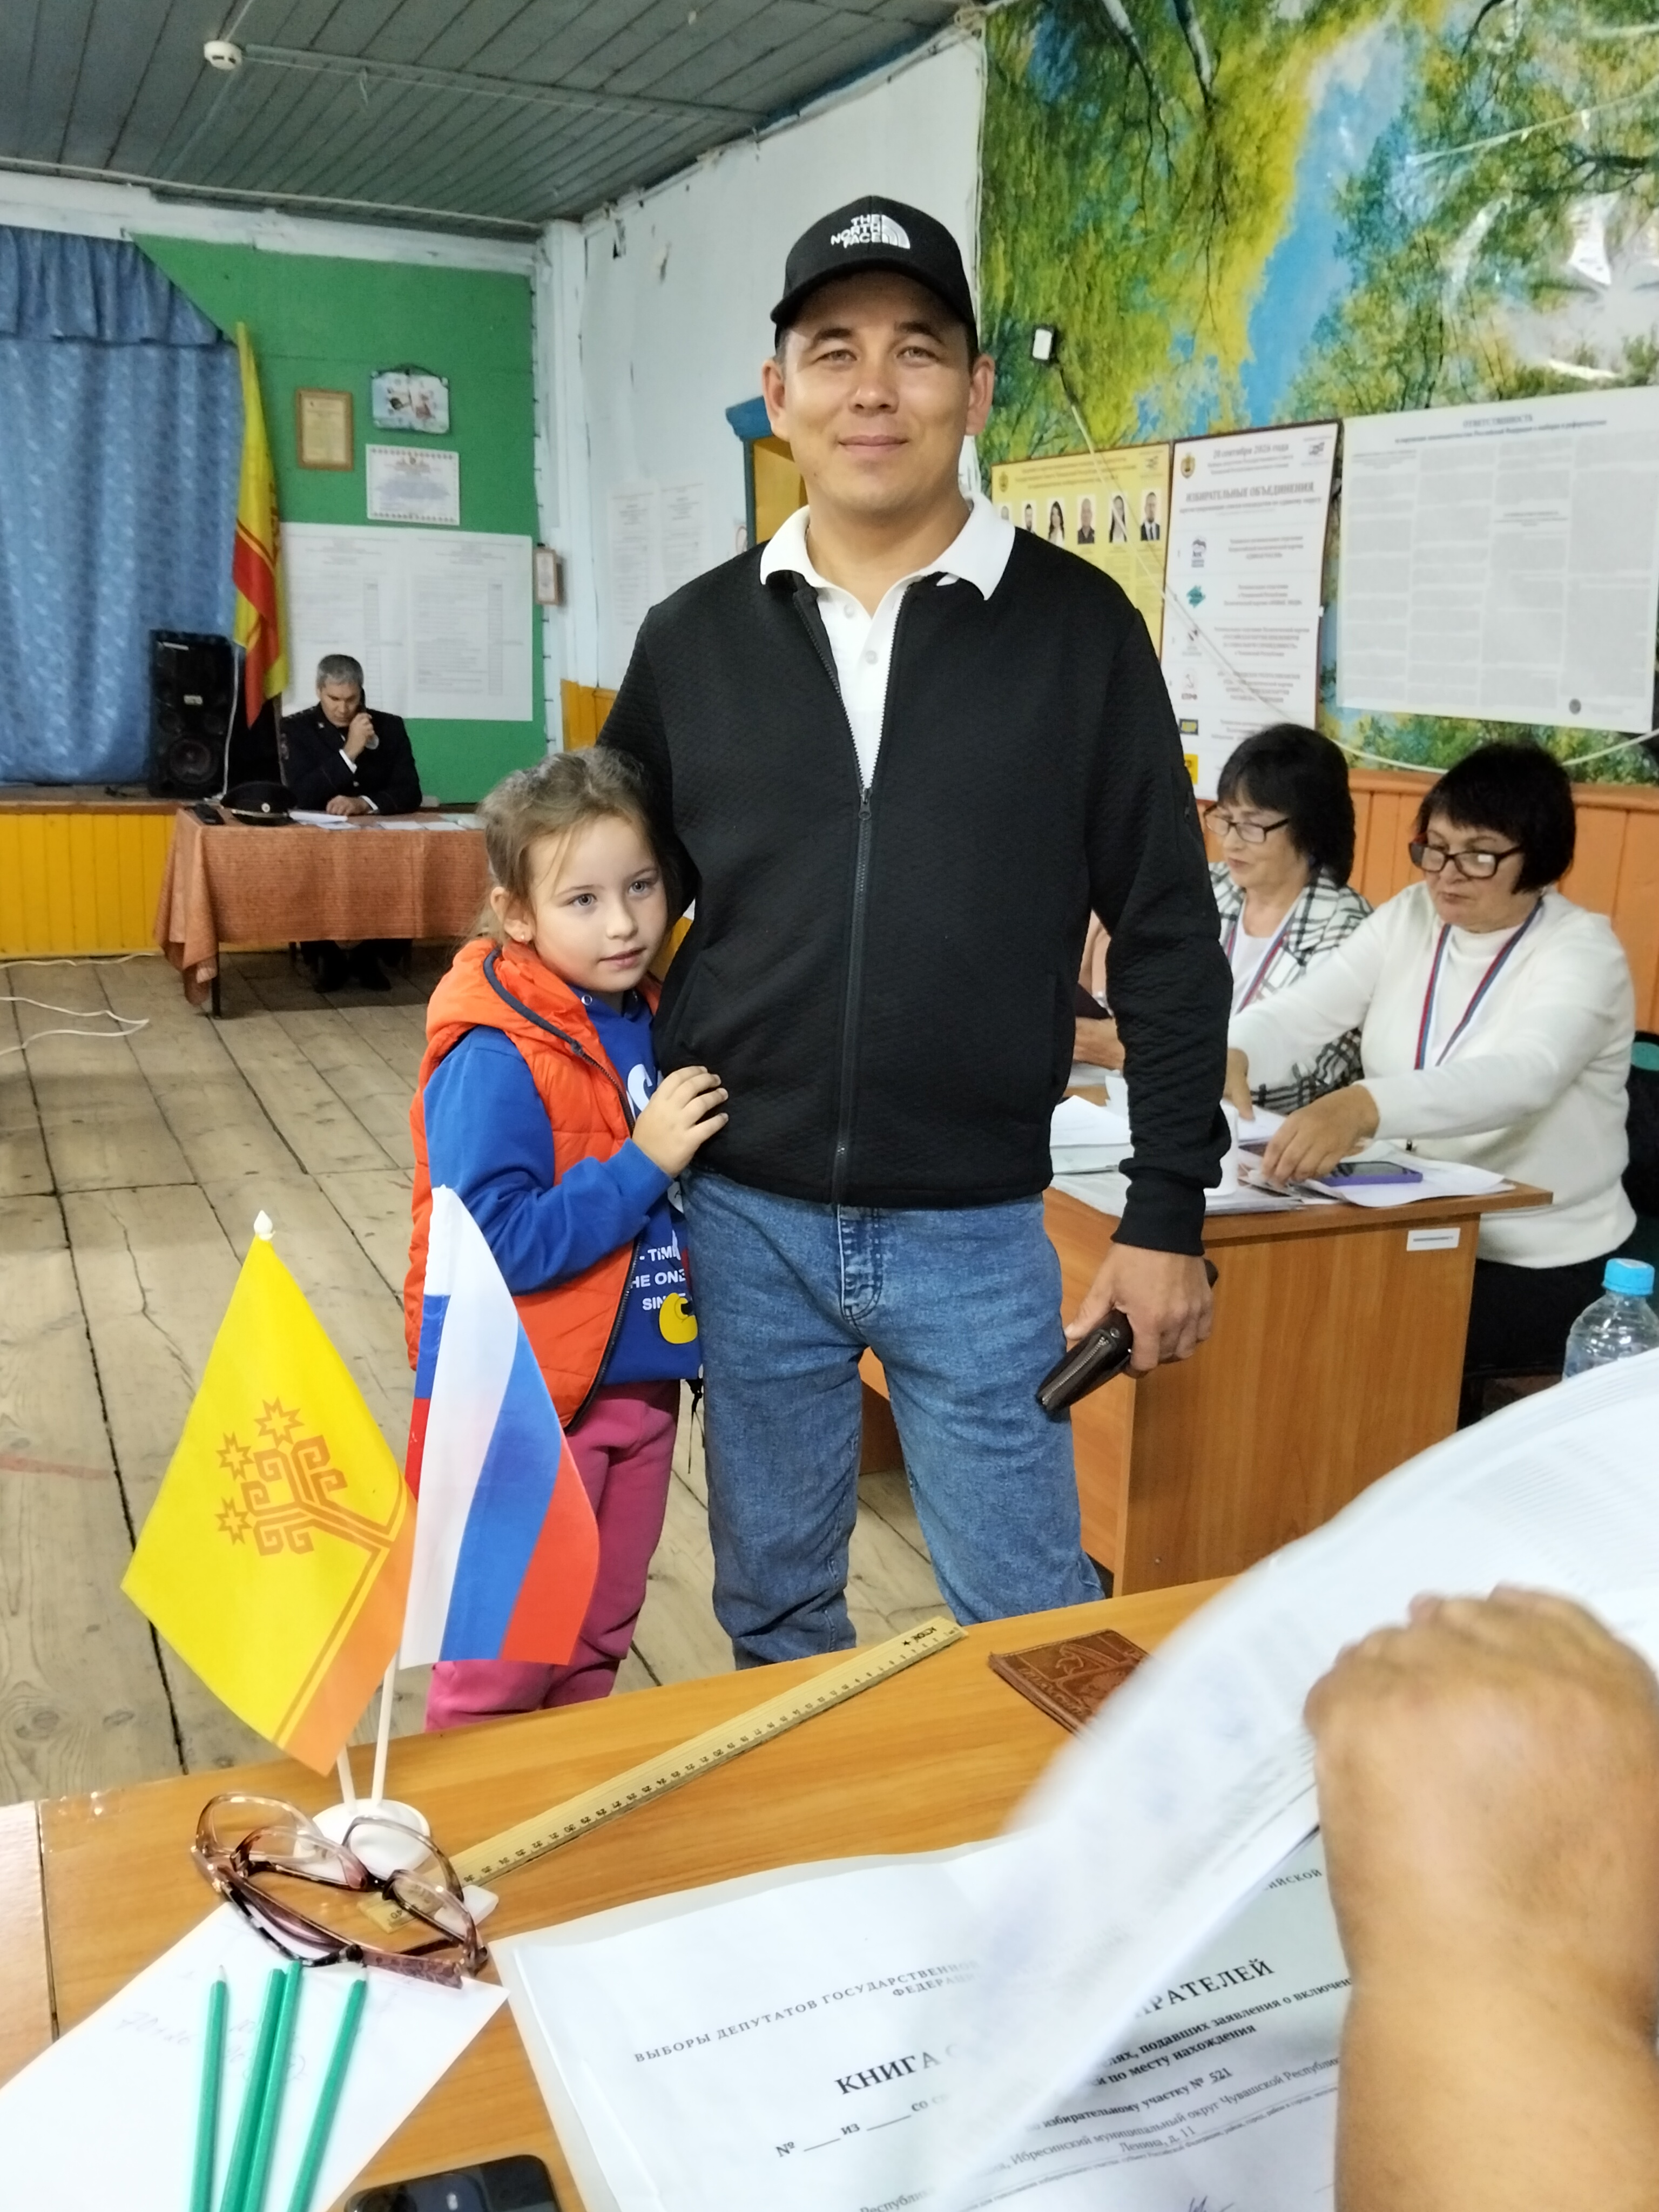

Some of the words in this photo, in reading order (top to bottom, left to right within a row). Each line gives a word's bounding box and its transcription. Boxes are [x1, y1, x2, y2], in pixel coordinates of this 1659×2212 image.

[831, 223, 880, 245] NORTH
[851, 214, 880, 227] THE
[844, 232, 881, 248] FACE
[631, 1274, 651, 1288] HE
[634, 2033, 711, 2062] ВЫБОРЫ
[717, 2000, 818, 2040] ДЕПУТАТОВ
[1265, 1868, 1323, 1890] ИЙСКОЙ
[892, 1973, 984, 1997] ФЕДЕРАЦИ
[834, 2052, 942, 2095] КНИГА
[1141, 1958, 1276, 2014] РАТЕЛЕЙ
[1138, 2021, 1210, 2054] подавших
[1210, 2000, 1282, 2028] заявления
[1293, 1978, 1353, 2001] включен
[1108, 2072, 1127, 2083] по
[1129, 2055, 1171, 2076] месту
[1171, 2024, 1257, 2061] нахождения
[1010, 2135, 1092, 2166] Ибресинский
[1093, 2113, 1186, 2143] муниципальный
[1187, 2101, 1219, 2117] округ
[1220, 2075, 1284, 2105] Чувашской
[1283, 2056, 1340, 2081] Республик
[1043, 2103, 1140, 2128] избирательному
[1141, 2085, 1190, 2109] участку
[1209, 2067, 1233, 2084] 521
[841, 2123, 860, 2135] из
[911, 2100, 929, 2112] со
[1119, 2139, 1169, 2153] Ленина,
[1181, 2126, 1196, 2137] 11
